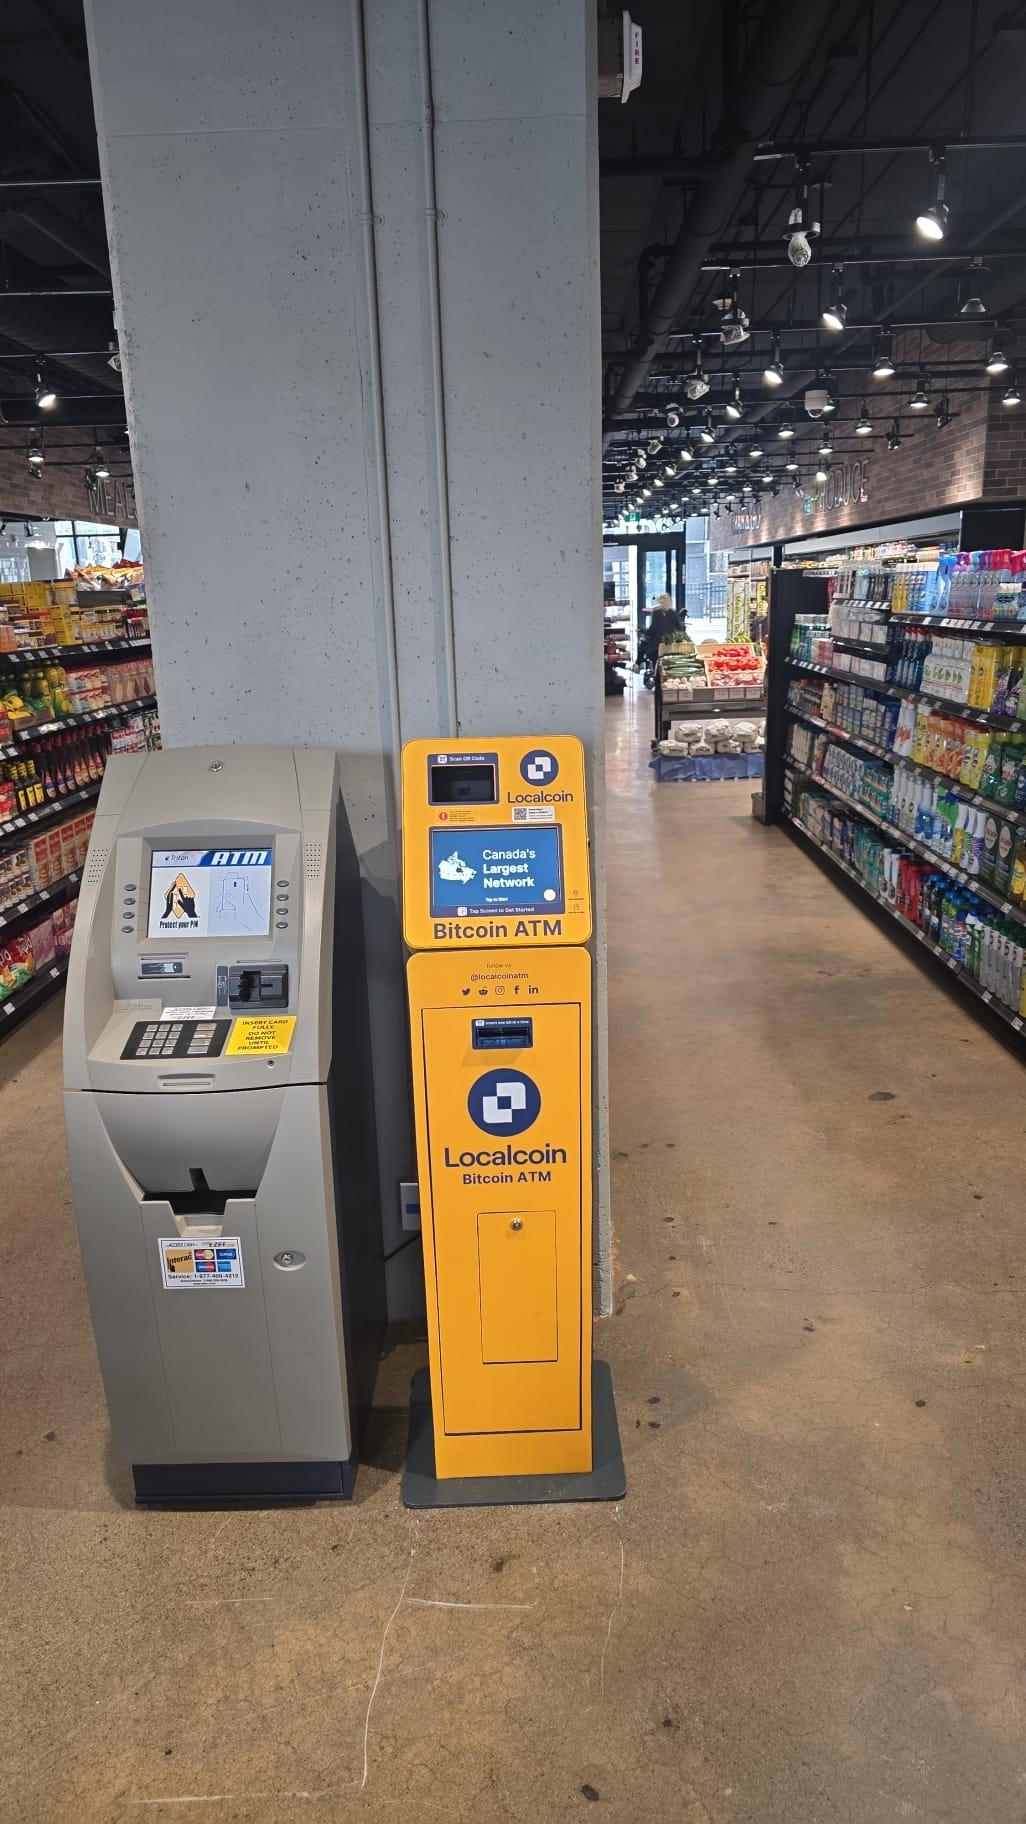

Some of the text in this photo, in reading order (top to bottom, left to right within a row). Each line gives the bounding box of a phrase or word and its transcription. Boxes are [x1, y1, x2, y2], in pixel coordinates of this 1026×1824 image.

[88, 478, 137, 519] MEAL
[507, 790, 574, 804] Localcoin
[211, 851, 268, 865] ATM
[482, 849, 536, 860] Canada's
[483, 863, 528, 876] Largest
[483, 877, 535, 888] Network
[178, 921, 189, 929] your
[190, 920, 198, 928] PIN
[433, 919, 562, 940] Bitcoin ATM
[470, 972, 529, 982] @localcoinatm
[444, 1143, 567, 1168] Localcoin
[463, 1170, 552, 1185] Bitcoin ATM
[166, 1254, 192, 1265] Interac
